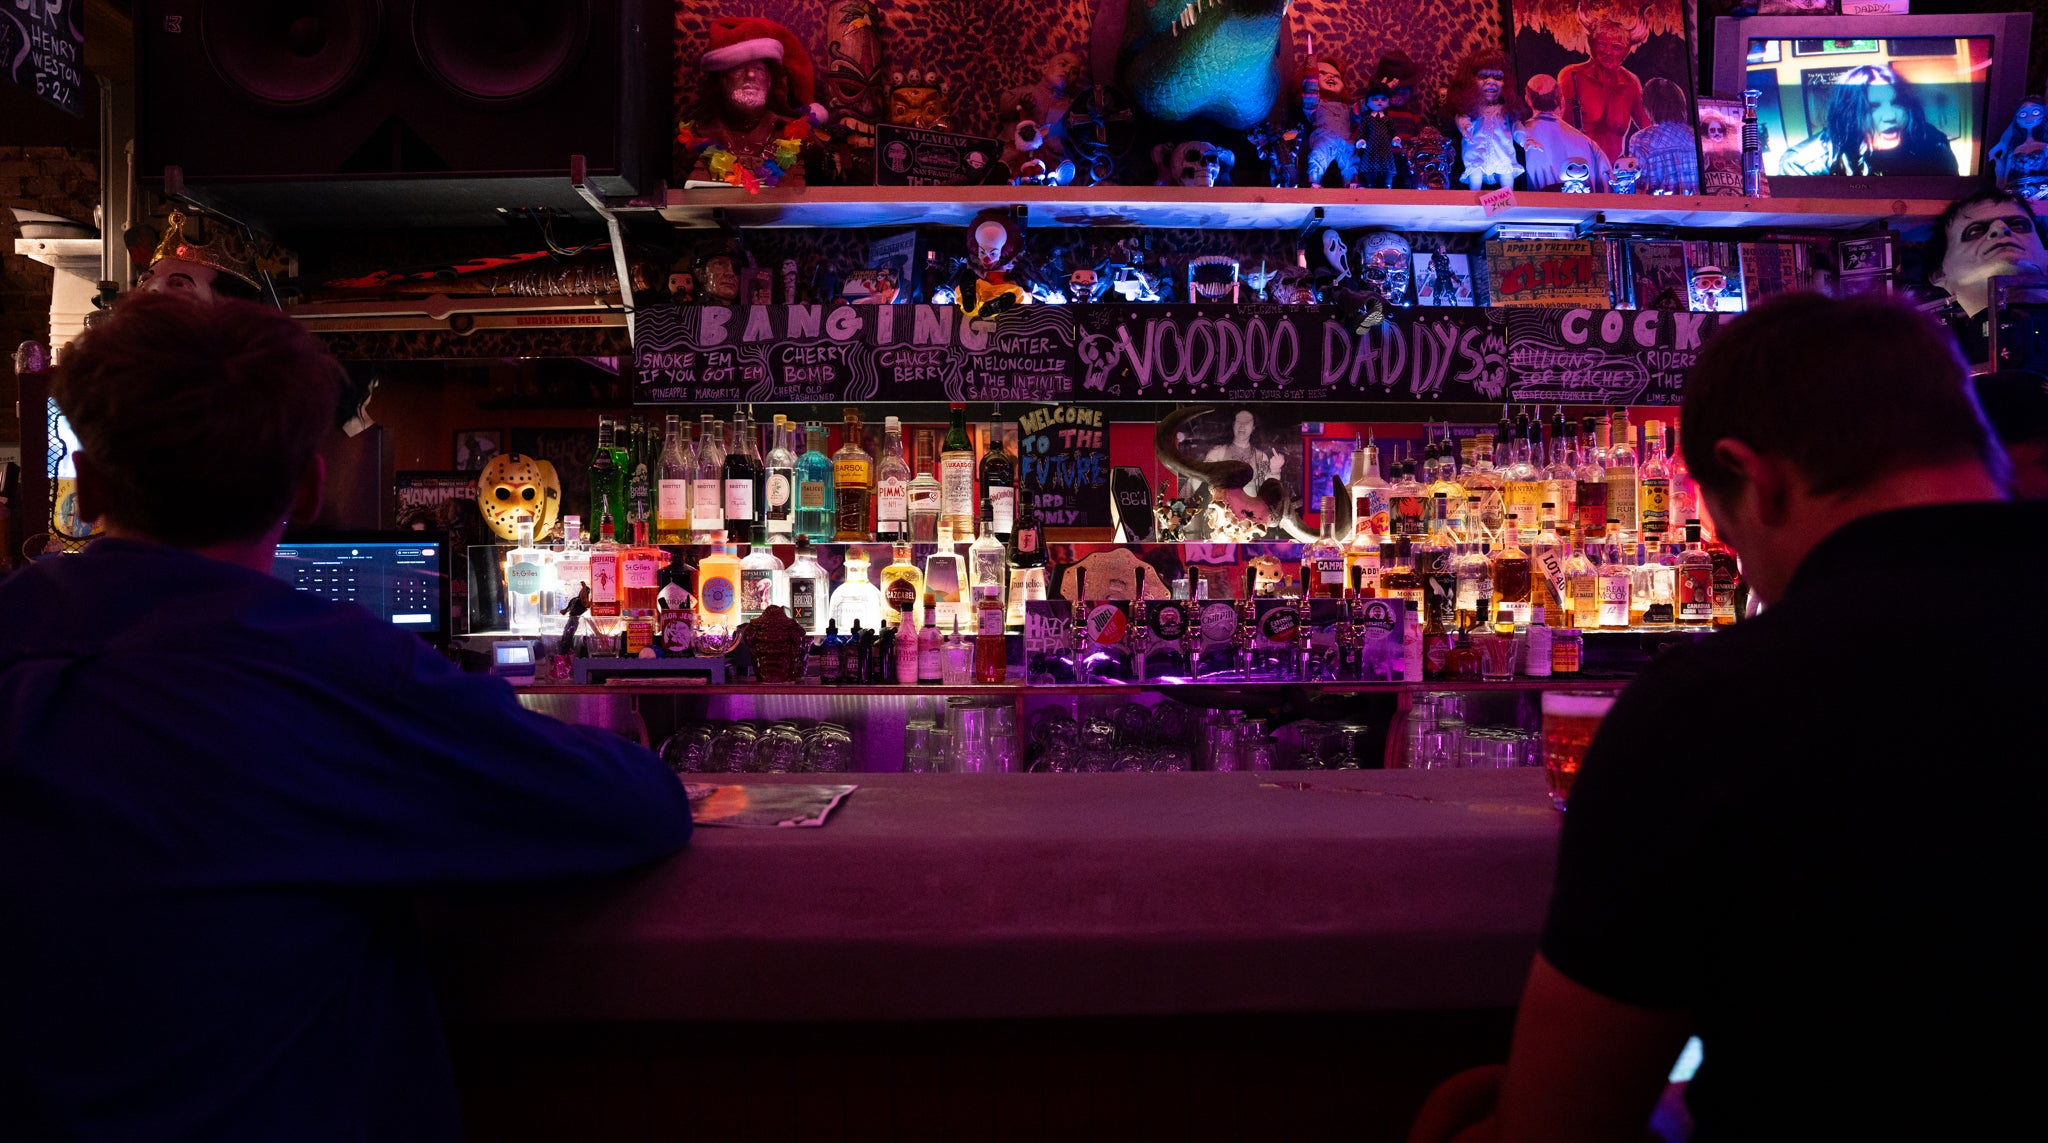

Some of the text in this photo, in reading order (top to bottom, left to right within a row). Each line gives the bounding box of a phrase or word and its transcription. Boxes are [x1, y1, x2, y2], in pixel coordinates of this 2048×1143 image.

[32, 24, 76, 62] HENRY
[32, 51, 81, 87] WESTON
[906, 130, 968, 148] ALCATRAZ
[1507, 243, 1589, 252] APOLLO THEATRE
[1306, 305, 1321, 313] THE
[517, 316, 603, 326] BURNS LIKE HELL
[700, 304, 997, 350] BANGING
[1000, 338, 1058, 354] WATER-
[1117, 318, 1299, 388] VOODOO
[643, 353, 695, 369] SMOKE
[782, 347, 850, 365] CHERRY
[881, 352, 941, 367] CHUCK
[973, 356, 1066, 372] MELONCOLLIE
[1322, 318, 1483, 394] DADDYS
[1509, 348, 1595, 370] MILLIONS
[639, 370, 659, 384] IF
[665, 369, 696, 384] YOU
[703, 367, 735, 382] GOT
[784, 366, 835, 383] BOMB
[894, 366, 949, 383] BERRY
[980, 375, 1006, 387] THE
[1012, 374, 1073, 392] INFINITE
[1561, 369, 1635, 389] PEACHES
[1651, 372, 1684, 389] THE
[652, 387, 740, 399] PINEAPPLE MARGARITA
[774, 385, 822, 396] CHERRY OLD
[790, 393, 834, 401] FASHIONED
[968, 387, 1054, 400] SADDNESS
[1019, 406, 1104, 436] WELCOME
[1022, 428, 1103, 454] TO THE
[835, 464, 864, 472] BARSOL
[1021, 453, 1108, 489] FUTURE
[880, 485, 905, 497] PIMM'S
[1033, 493, 1064, 508] ARD
[591, 556, 616, 564] BEEFEATER
[1543, 555, 1566, 592] LOT 40
[886, 591, 915, 600] CAZCABEL
[1027, 612, 1069, 639] HAZY
[1091, 608, 1113, 633] JUBEL
[1202, 610, 1233, 625] Chill Pill
[1027, 638, 1064, 654] IPA
